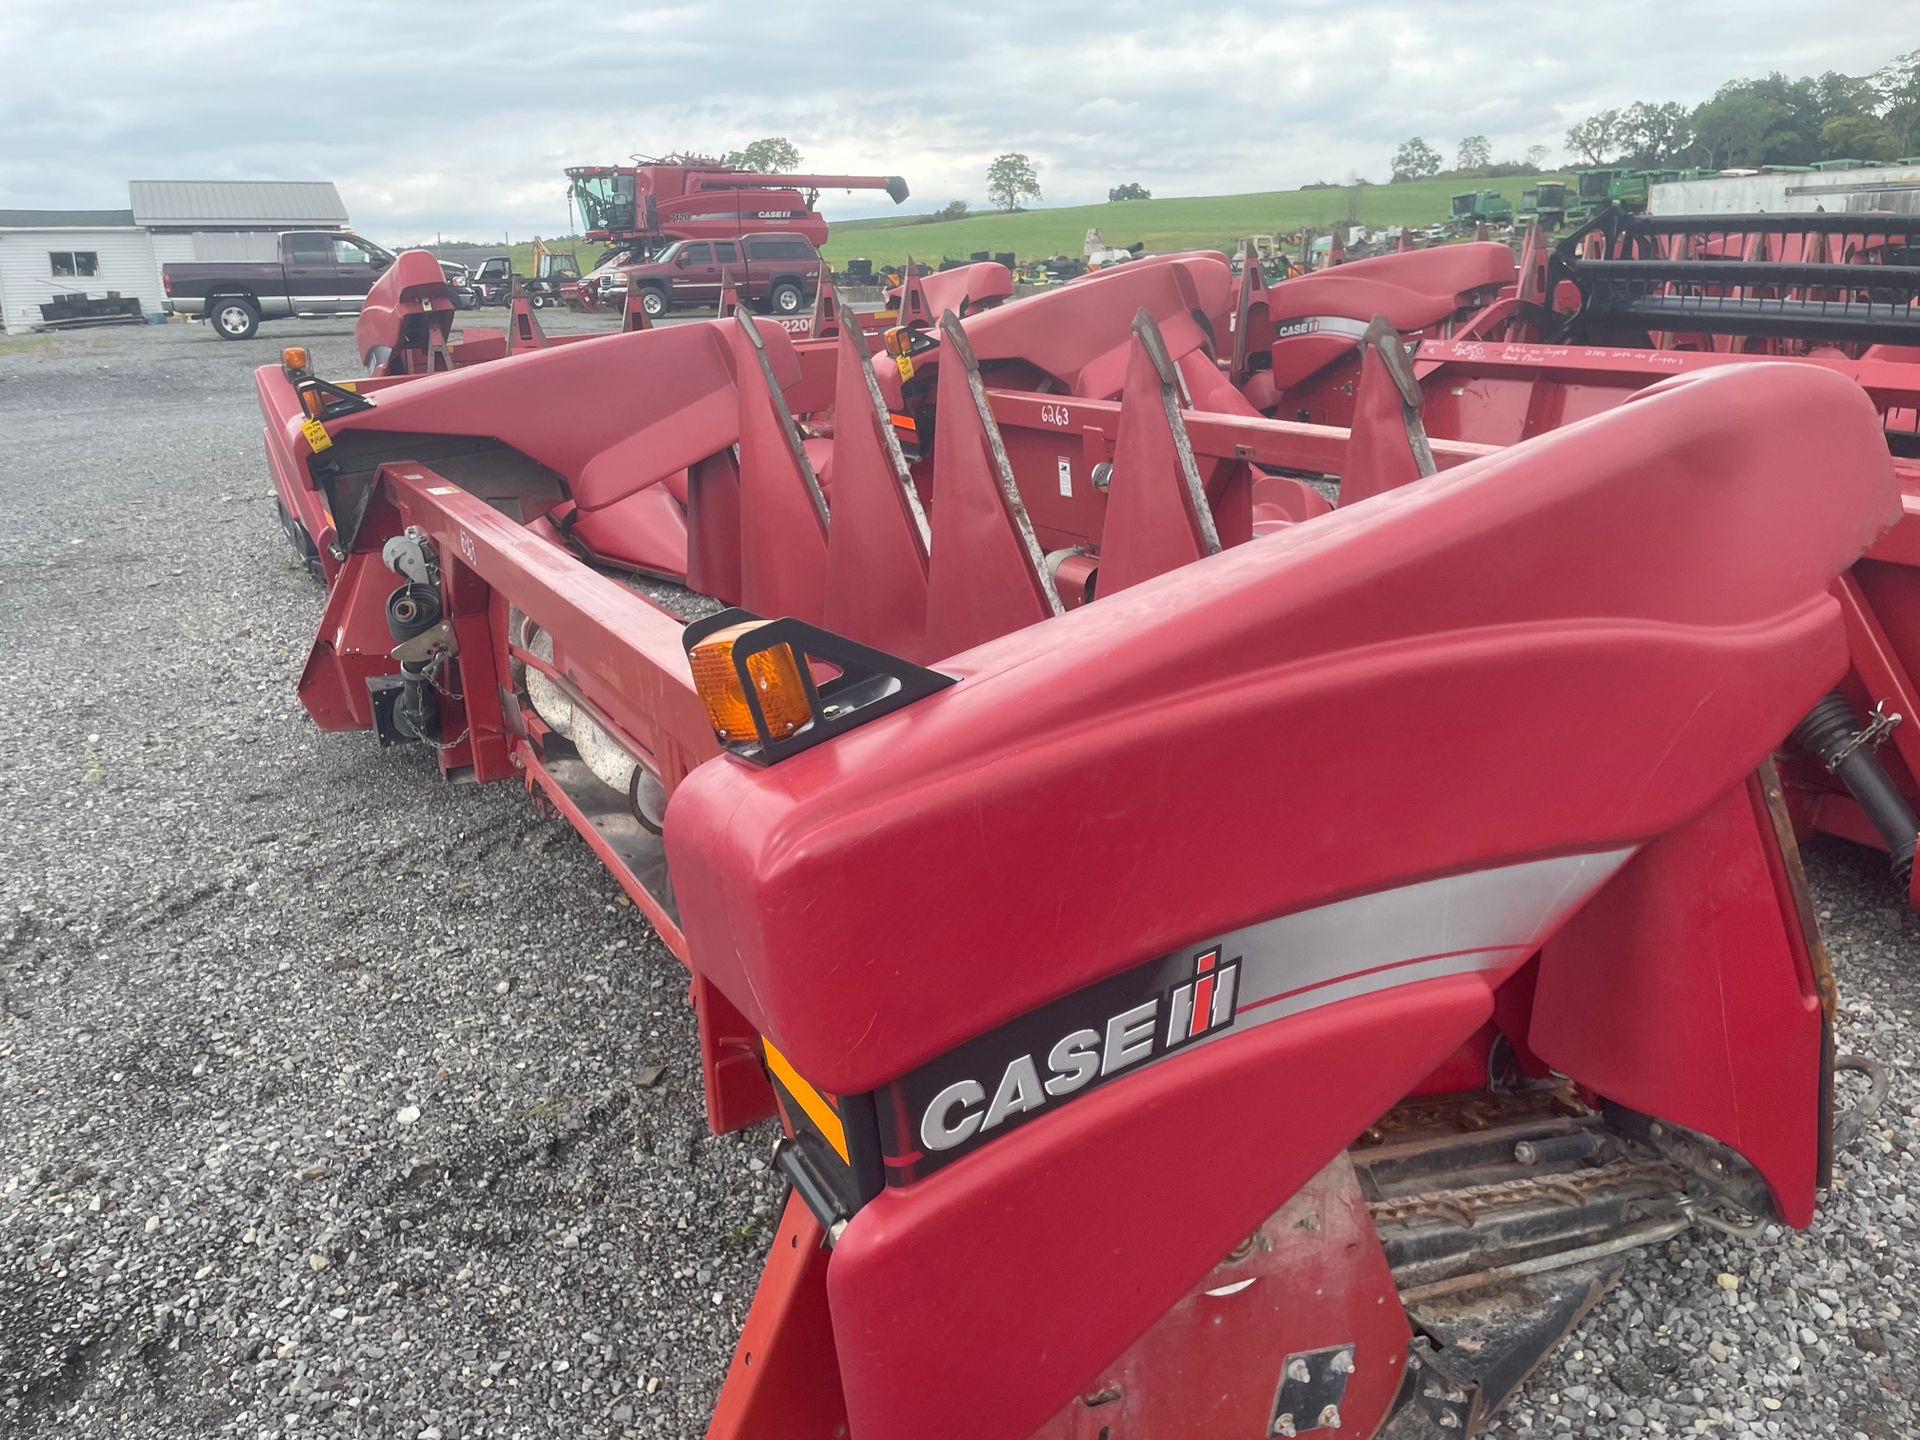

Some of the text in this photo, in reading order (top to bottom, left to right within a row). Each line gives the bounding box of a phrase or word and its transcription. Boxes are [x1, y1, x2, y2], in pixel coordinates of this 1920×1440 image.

[758, 210, 782, 218] CASE
[1279, 323, 1309, 337] CASE
[1041, 405, 1069, 426] 6263
[920, 998, 1158, 1150] CASE
